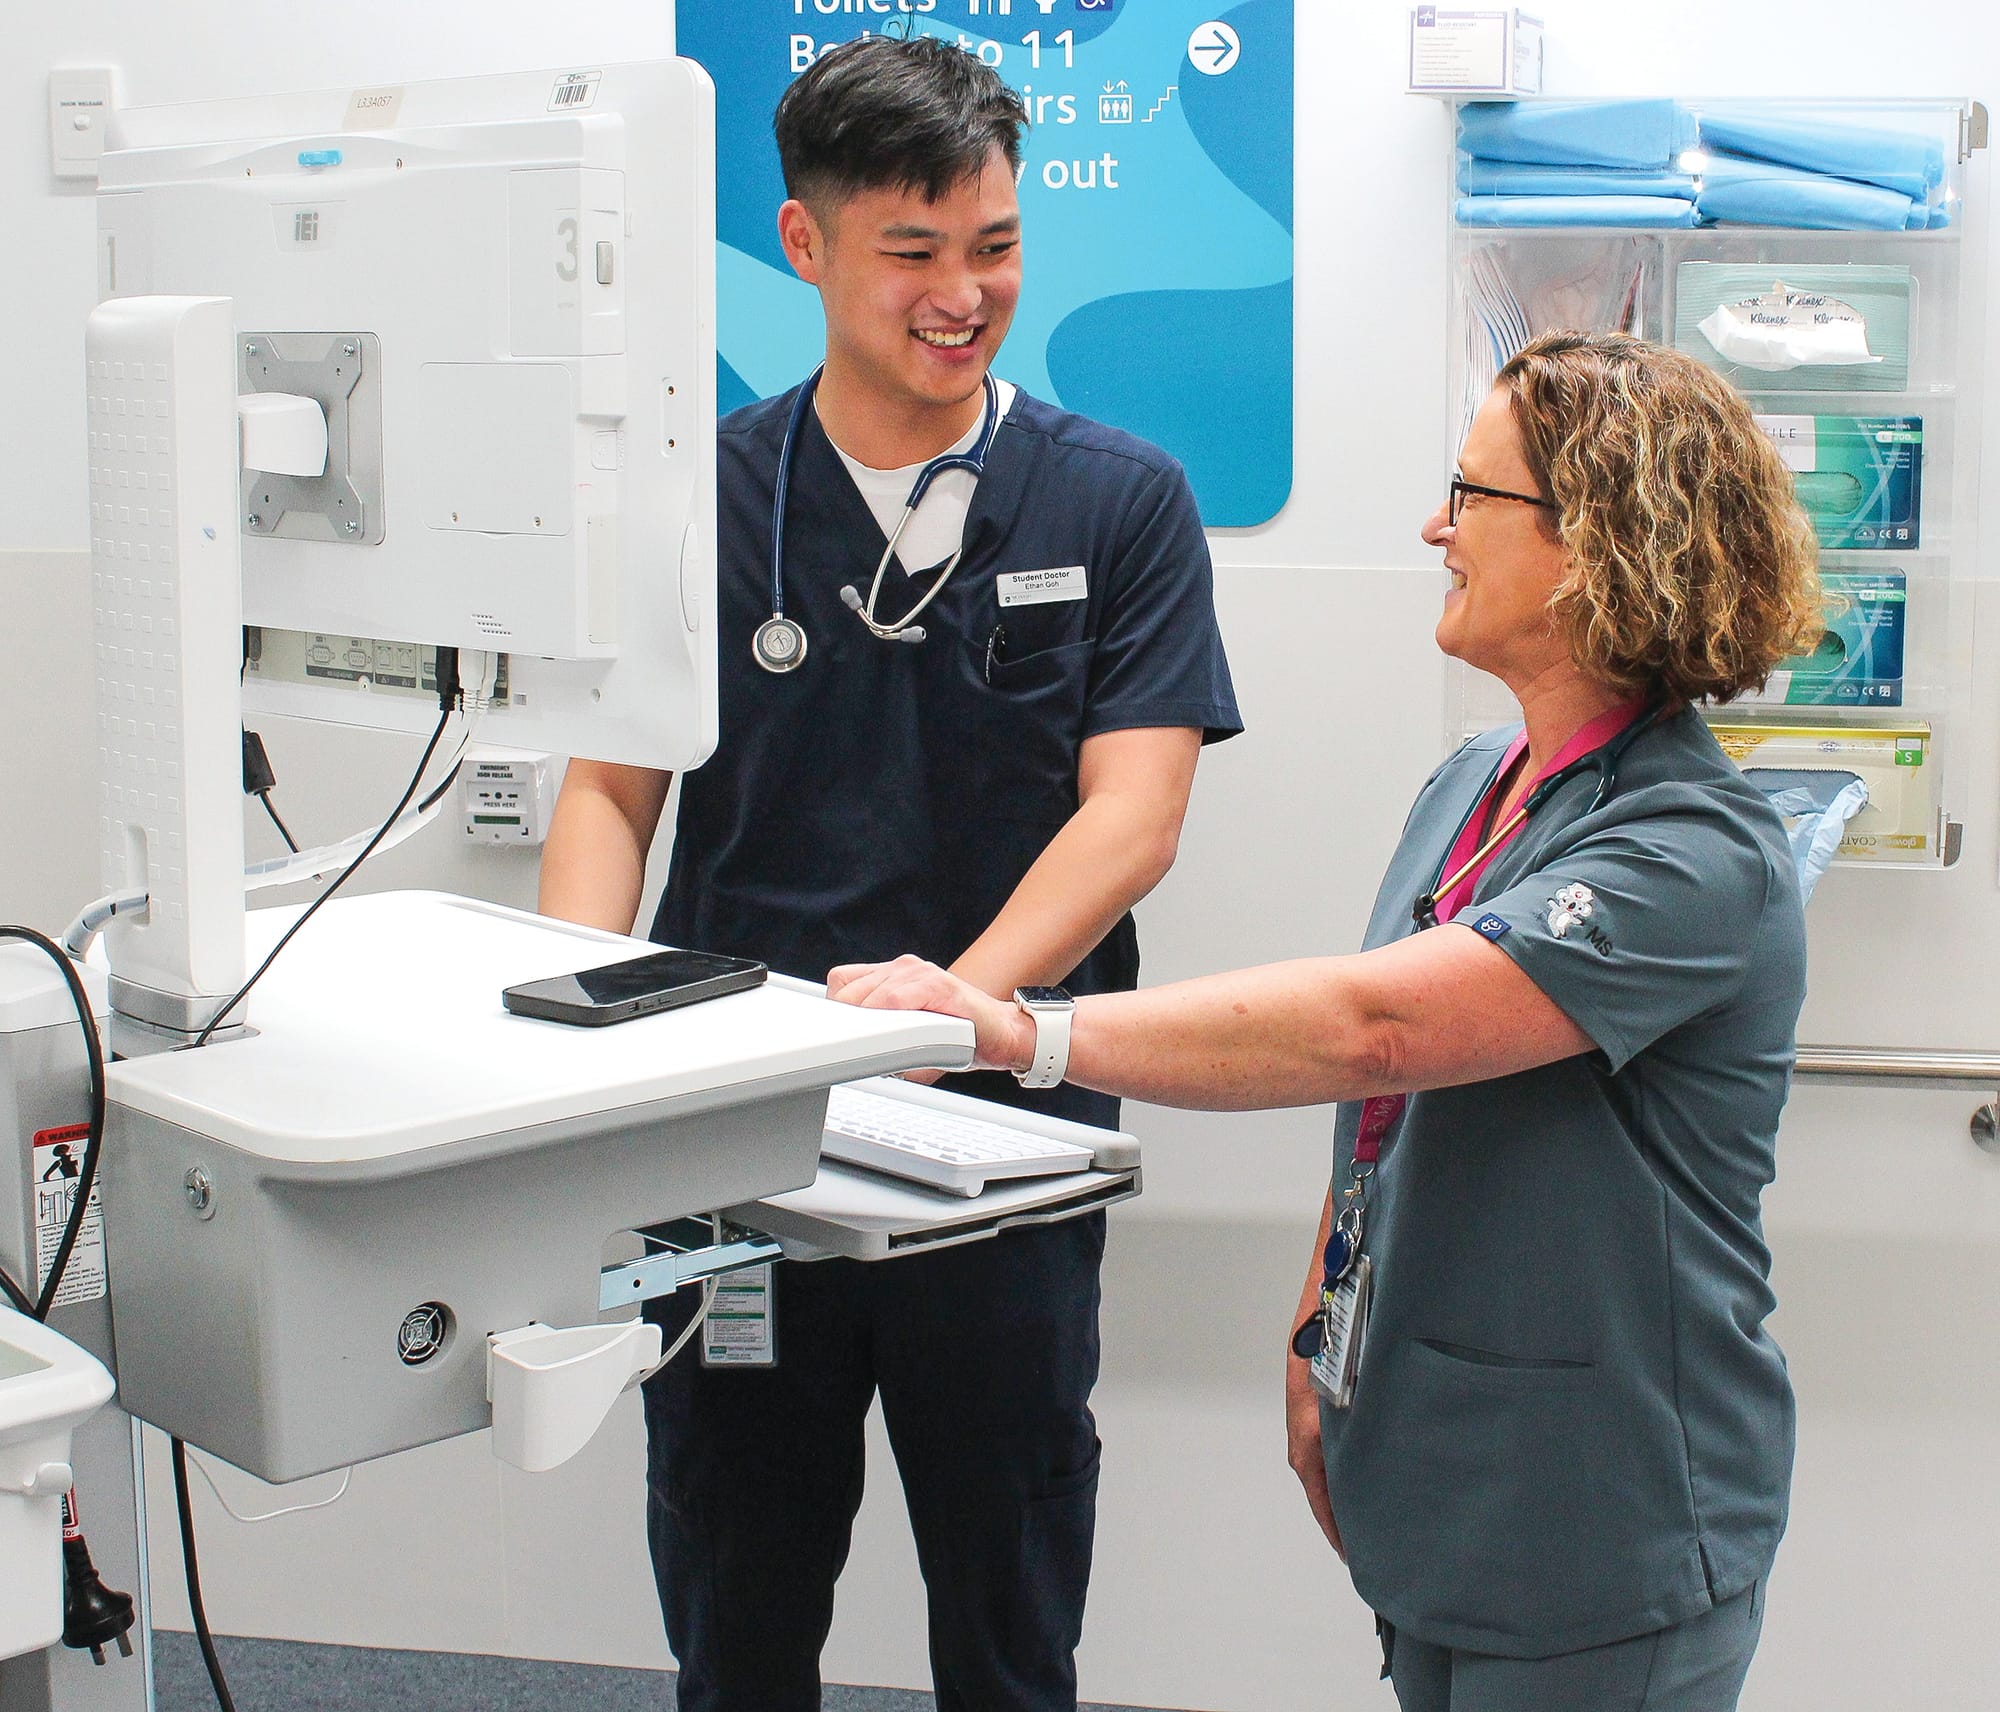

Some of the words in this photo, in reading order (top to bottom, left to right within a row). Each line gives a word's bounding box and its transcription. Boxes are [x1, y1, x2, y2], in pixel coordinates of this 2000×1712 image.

[1021, 29, 1073, 68] 11
[1023, 85, 1077, 124] irs
[1042, 152, 1119, 189] out
[556, 218, 578, 282] 3
[1750, 313, 1789, 326] Kleenex
[1012, 574, 1042, 582] Student
[1044, 571, 1070, 580] Doctor
[1904, 752, 1912, 762] S
[1585, 926, 1613, 957] MS
